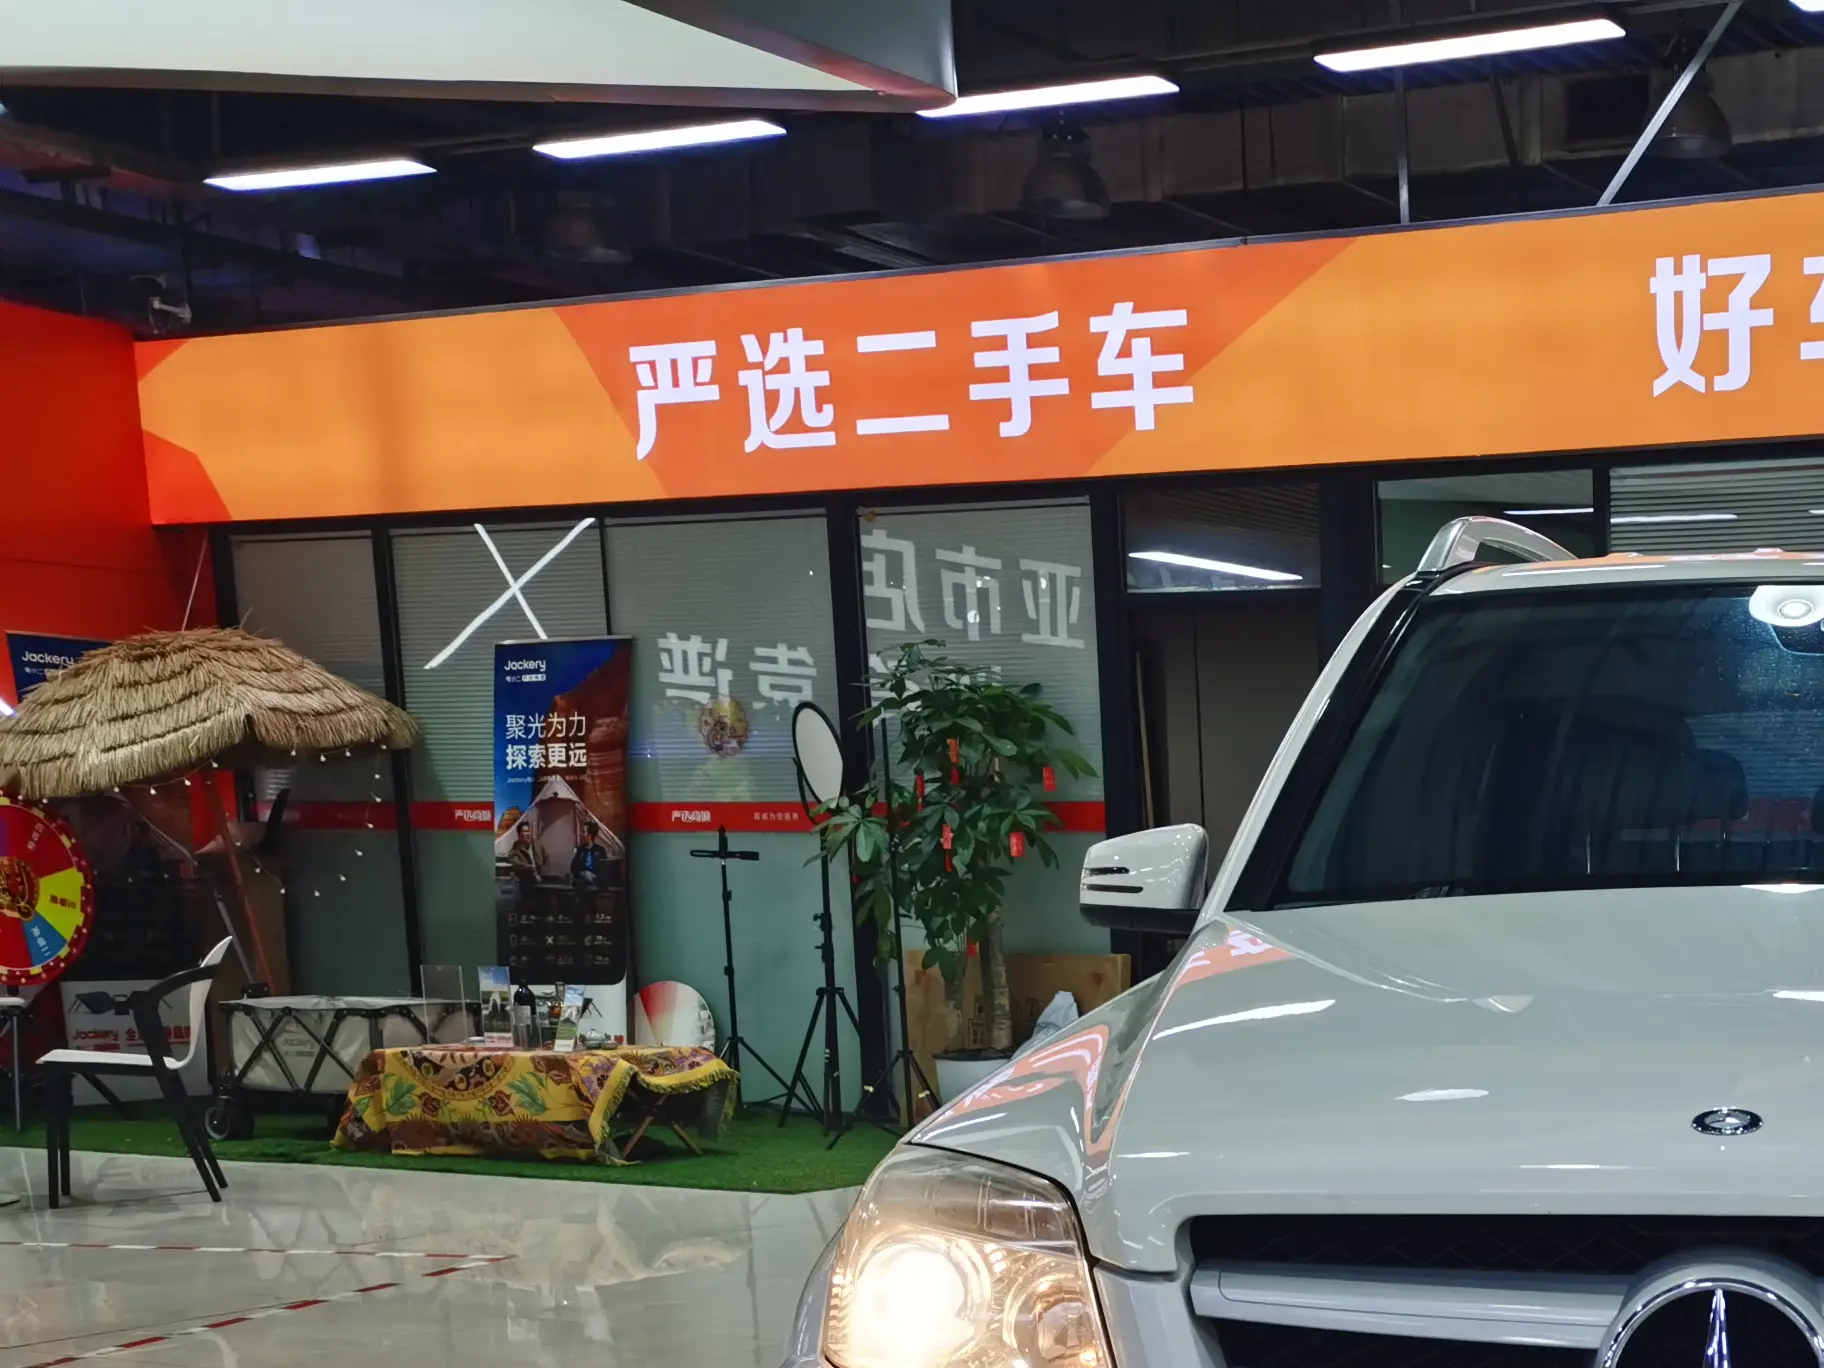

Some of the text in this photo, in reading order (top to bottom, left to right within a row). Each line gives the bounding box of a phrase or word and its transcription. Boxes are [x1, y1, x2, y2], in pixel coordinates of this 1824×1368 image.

[629, 301, 1194, 461] 严选二手车
[504, 660, 546, 672] Jackery
[505, 712, 587, 740] 聚光为力
[506, 743, 588, 770] 探索更远
